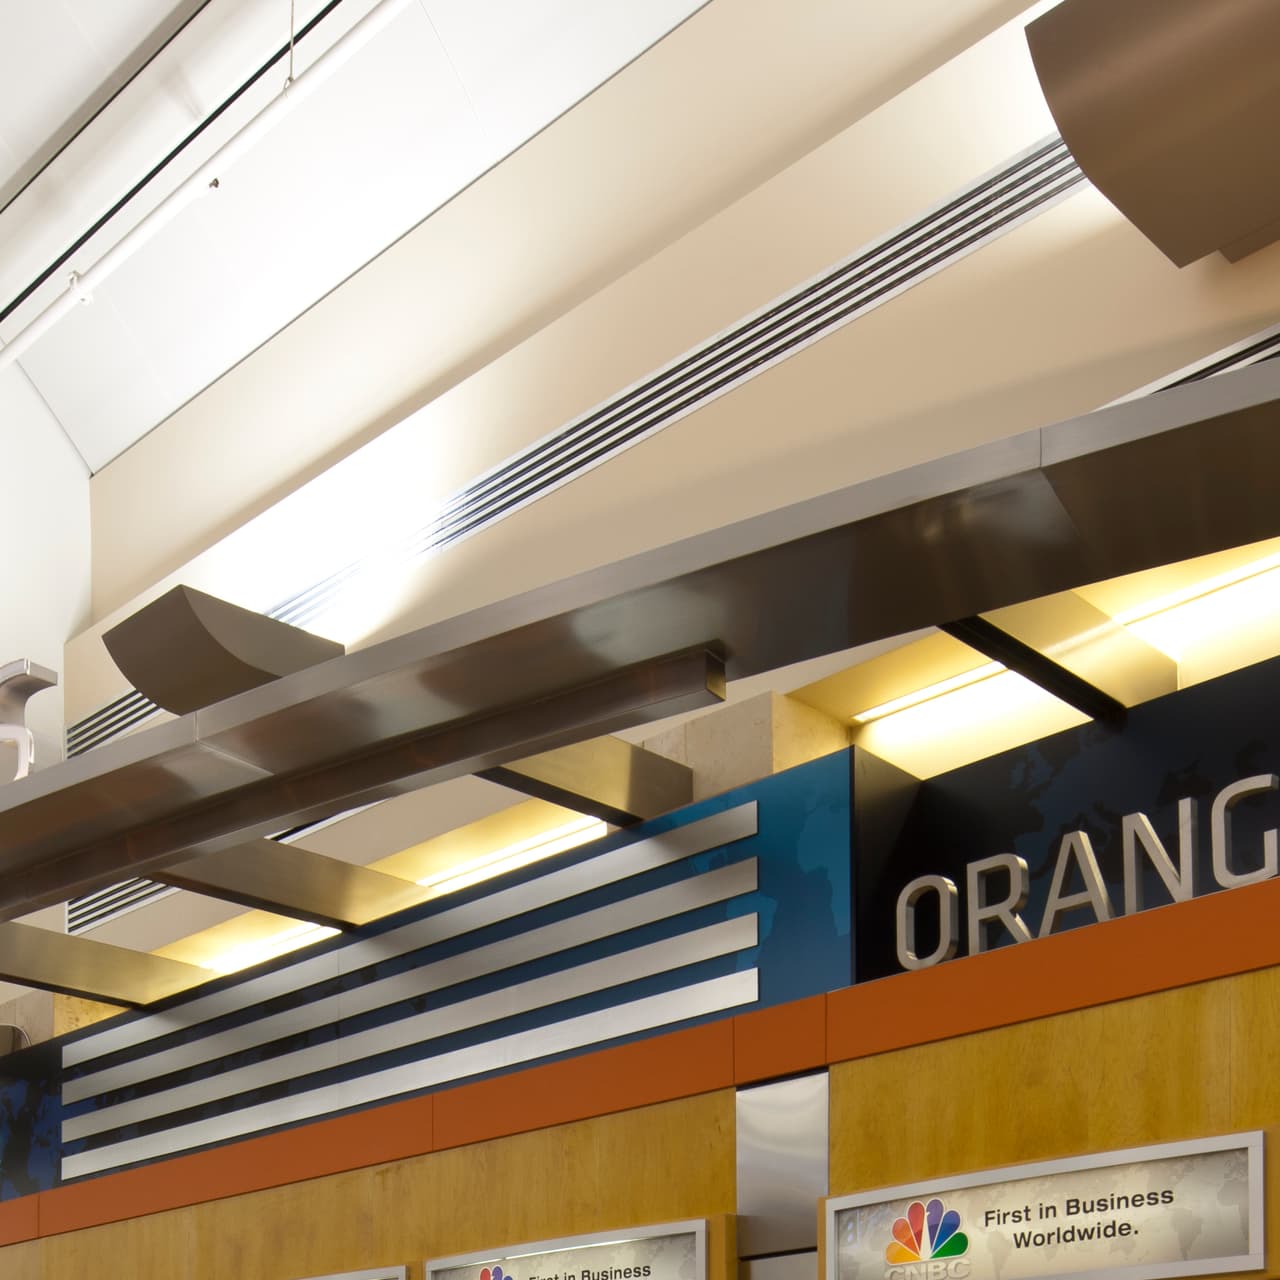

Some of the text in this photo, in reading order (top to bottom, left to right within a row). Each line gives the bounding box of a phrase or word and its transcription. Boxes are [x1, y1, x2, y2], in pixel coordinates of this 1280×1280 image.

[984, 1189, 1174, 1227] First in Business
[1013, 1219, 1139, 1249] Worldwide.
